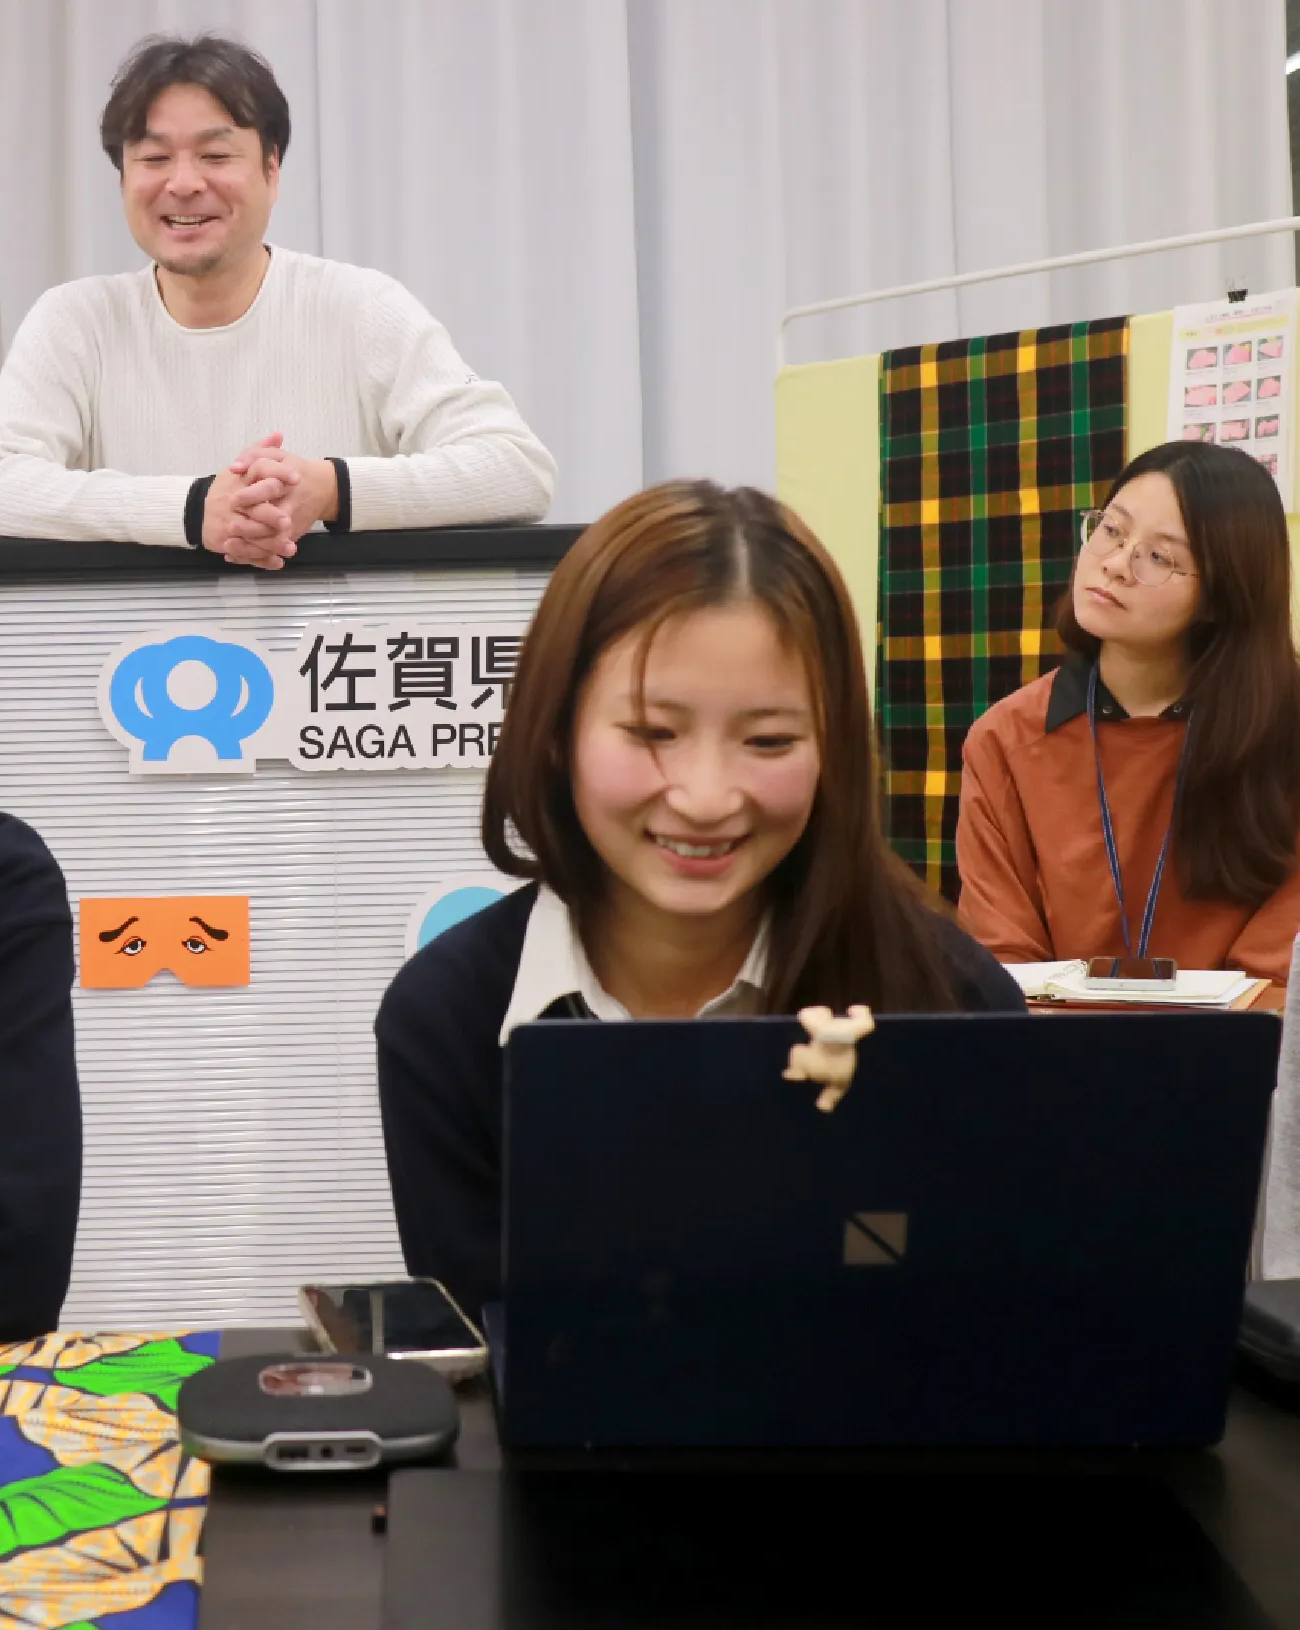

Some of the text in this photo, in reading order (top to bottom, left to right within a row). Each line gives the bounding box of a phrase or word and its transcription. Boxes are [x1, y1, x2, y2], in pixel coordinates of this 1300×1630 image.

[299, 632, 525, 712] 佐賀県
[299, 723, 416, 759] SAGA
